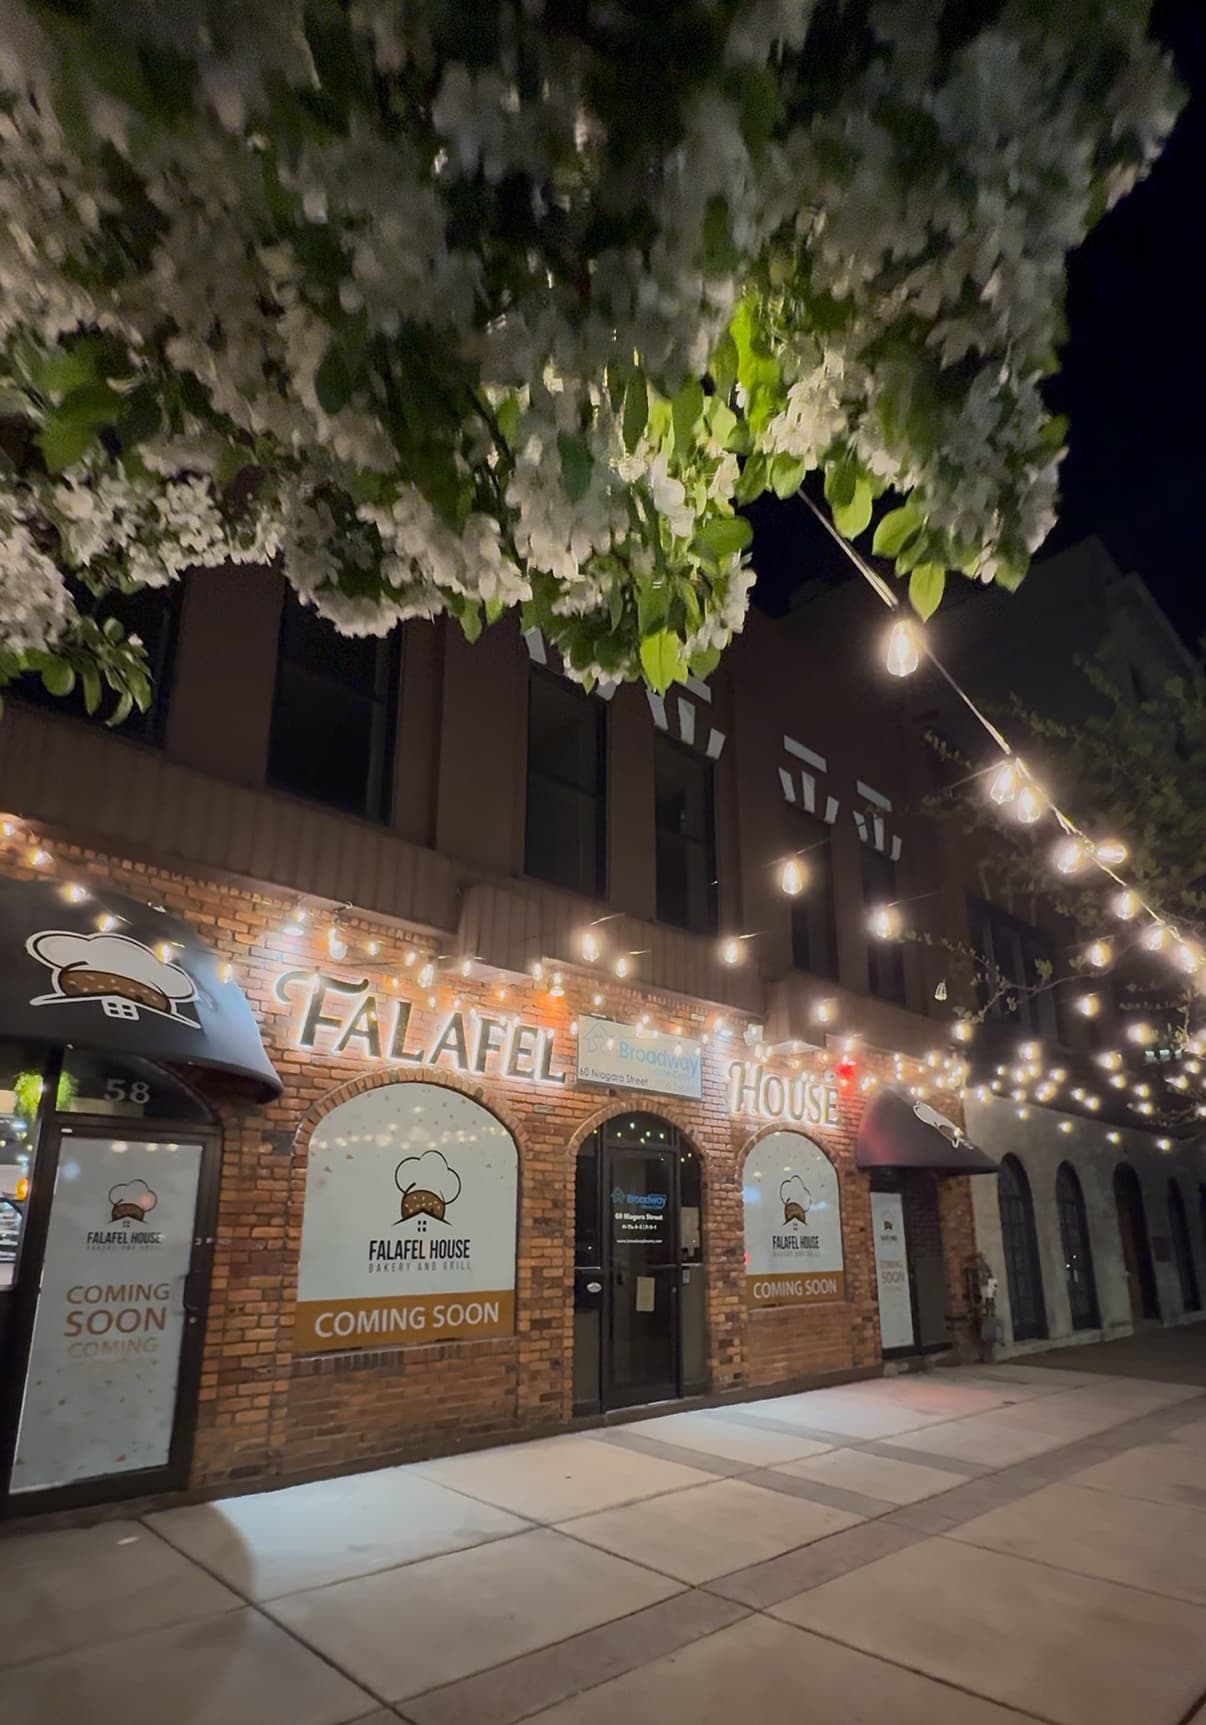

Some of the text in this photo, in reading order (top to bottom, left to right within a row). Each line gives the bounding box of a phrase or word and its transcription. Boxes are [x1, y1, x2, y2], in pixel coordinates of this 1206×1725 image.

[274, 970, 566, 1083] FALAFEL
[619, 1039, 700, 1080] Broadway
[580, 1066, 590, 1077] 60
[592, 1067, 625, 1082] Niagara
[626, 1073, 649, 1086] Street
[103, 1079, 150, 1104] 58
[728, 1060, 839, 1126] HOUSE
[86, 1231, 129, 1245] FALAFEL
[772, 1235, 799, 1250] FALAFEL
[368, 1239, 471, 1261] FALAFEL HOUSE
[368, 1261, 472, 1273] BAKERY AND GRILL
[66, 1283, 170, 1305] COMING
[753, 1279, 837, 1299] COMING SOON
[64, 1307, 167, 1337] SOON
[314, 1302, 500, 1339] COMING SOON
[67, 1337, 158, 1359] COMING
